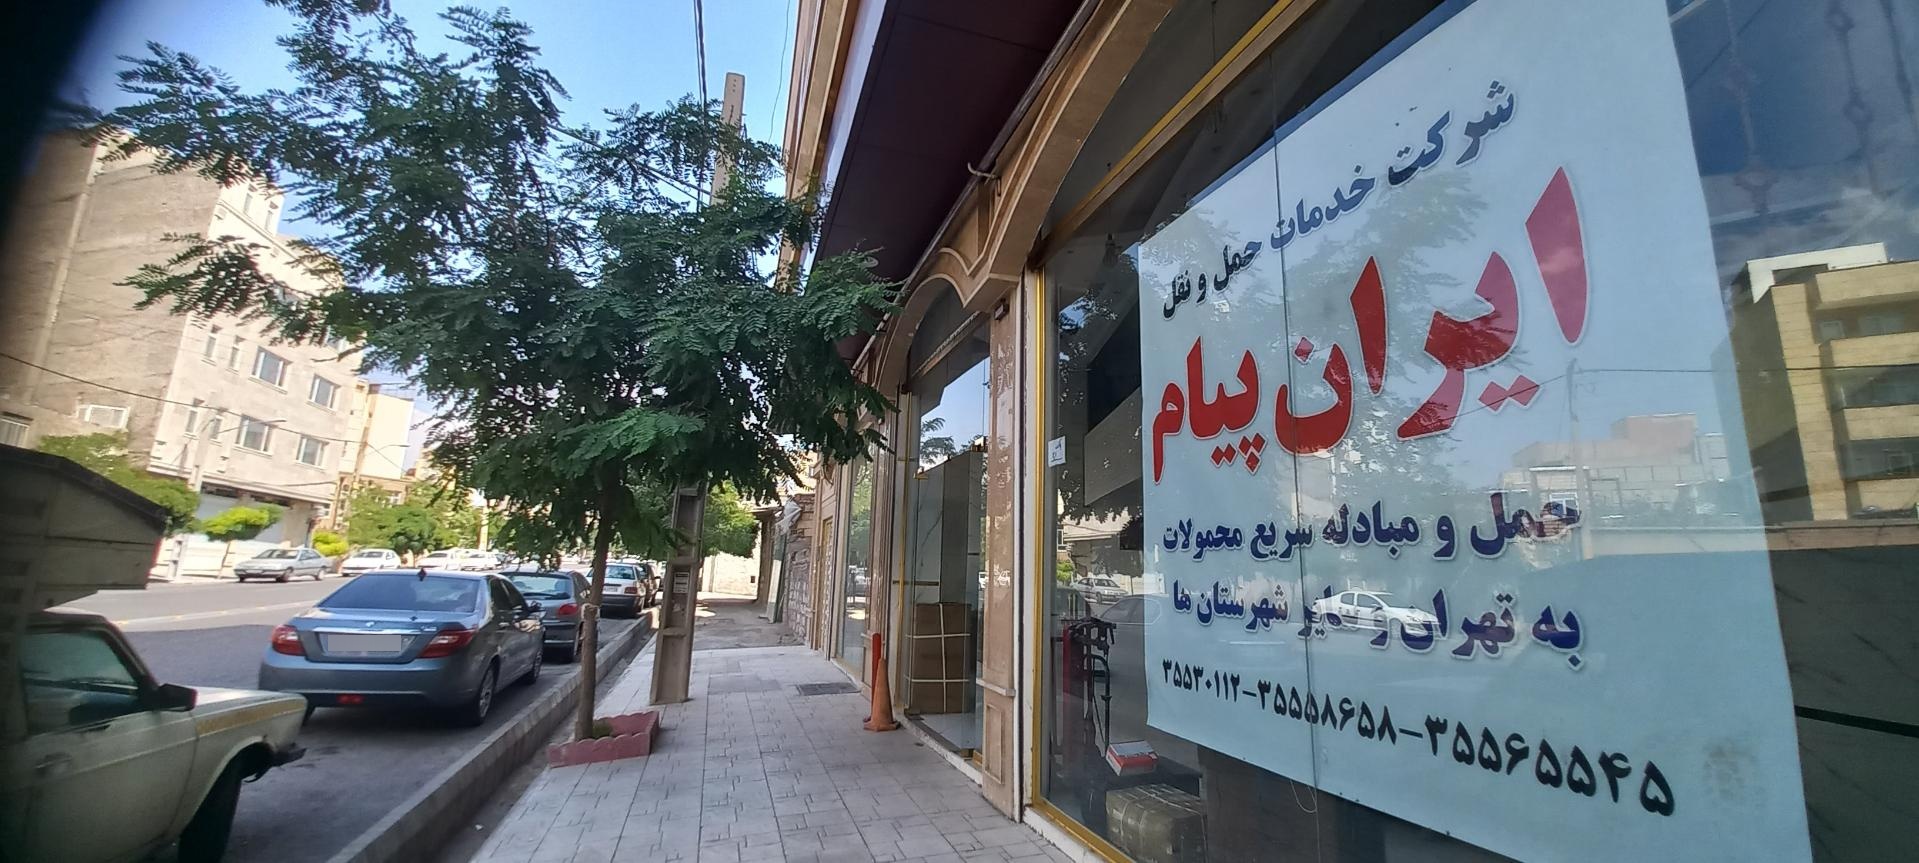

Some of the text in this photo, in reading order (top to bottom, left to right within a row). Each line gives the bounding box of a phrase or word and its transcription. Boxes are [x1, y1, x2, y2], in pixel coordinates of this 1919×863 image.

[1163, 80, 1515, 319] شرکت خدمات حمل و نقل
[1153, 165, 1588, 486] ایران پیام
[1163, 492, 1582, 559] حمل و مبادله سریع محمولات
[1173, 579, 1193, 611] ها
[1400, 588, 1516, 658] تهران
[1532, 605, 1582, 668] به
